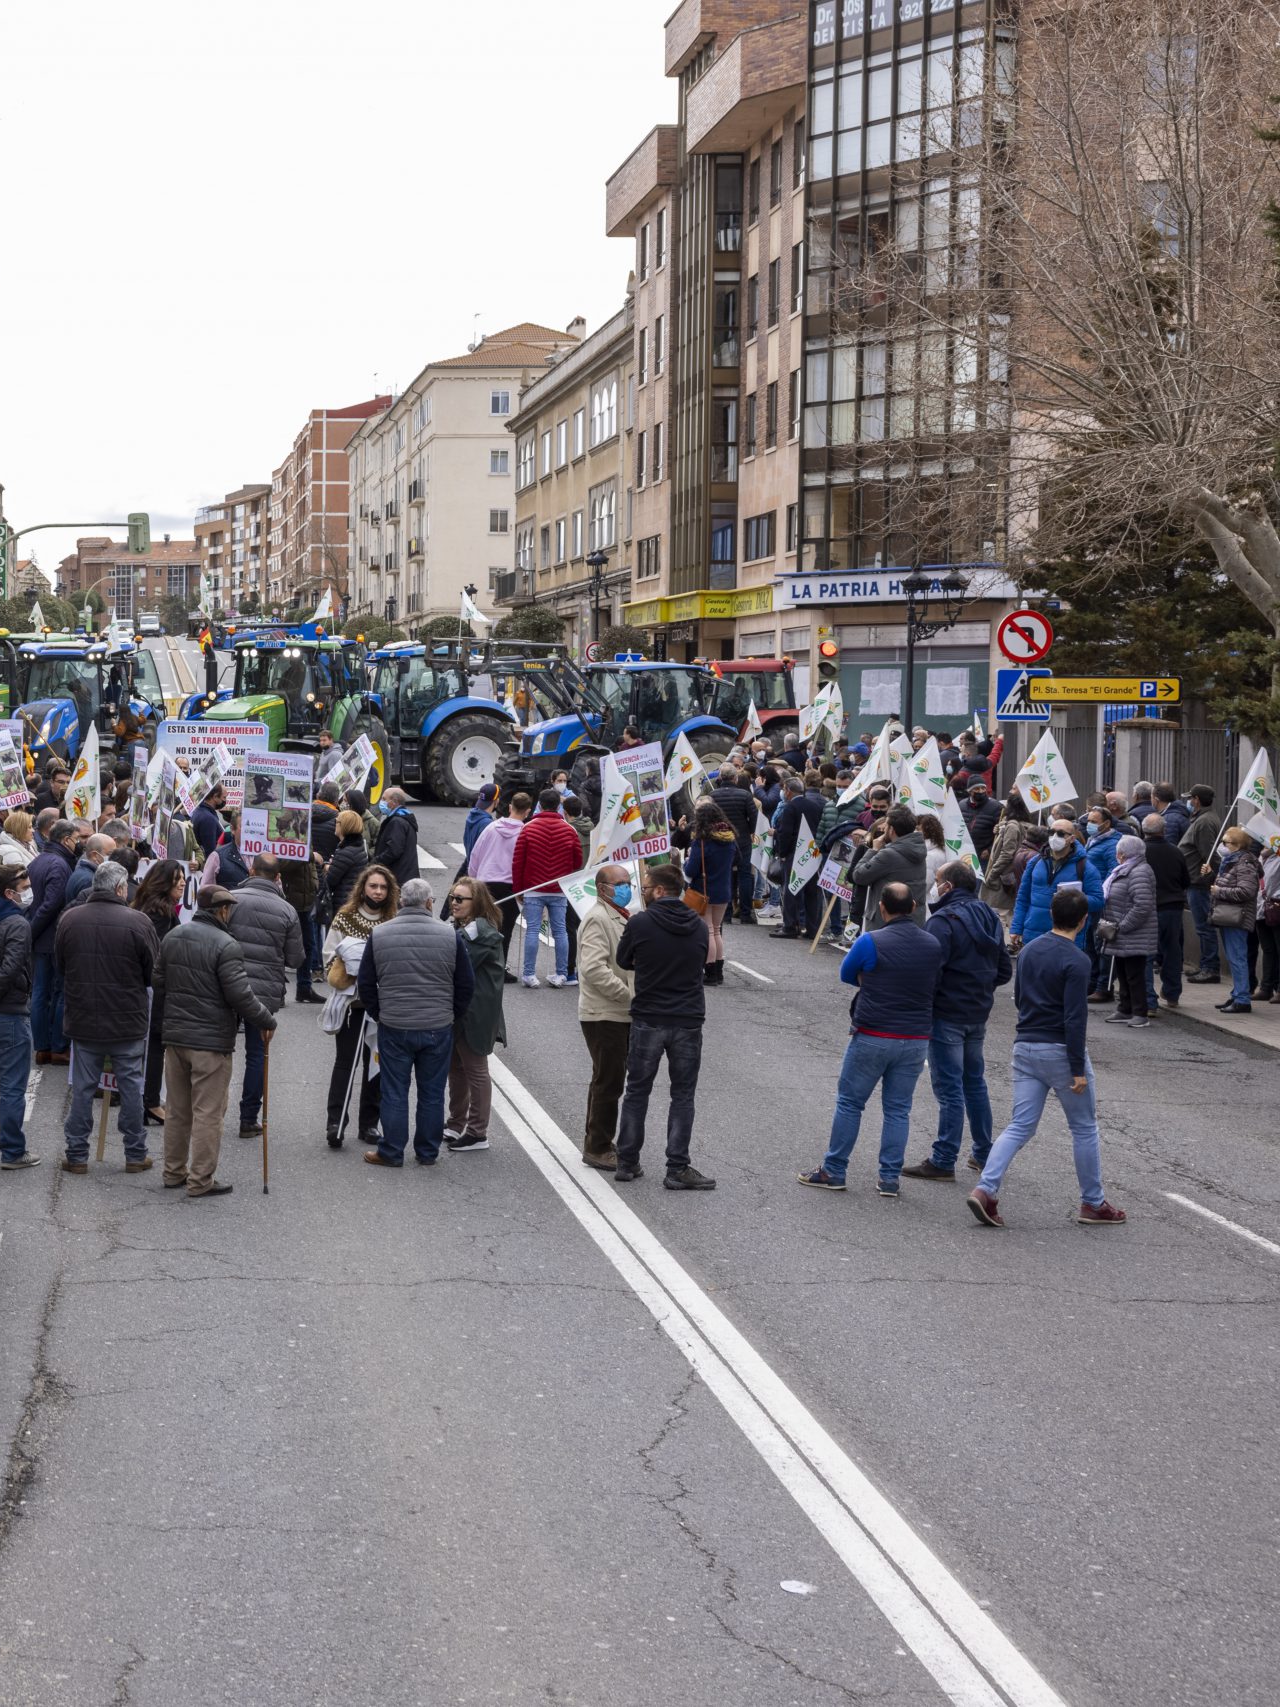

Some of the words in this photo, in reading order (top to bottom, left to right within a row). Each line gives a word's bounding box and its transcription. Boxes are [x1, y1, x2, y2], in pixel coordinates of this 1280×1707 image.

[818, 8, 833, 25] Dr.
[791, 584, 812, 599] LA
[819, 581, 880, 598] PATRIA
[1143, 682, 1154, 697] P
[167, 726, 186, 734] ESTA
[187, 726, 196, 734] ES
[198, 726, 208, 734] MI
[209, 726, 264, 735] HERRAMIENTA
[191, 736, 200, 744] DE
[176, 747, 186, 755] NO
[188, 747, 197, 755] ES
[199, 747, 209, 755] UN
[192, 757, 200, 765] MI
[248, 757, 288, 766] SUPERVIVENCIA
[247, 765, 279, 774] GANADERÍA
[5, 793, 27, 807] LOBO
[1246, 790, 1264, 807] UPA
[245, 840, 262, 853] NO
[263, 844, 270, 852] AL
[272, 843, 306, 858] LOBO
[612, 846, 628, 862] NO
[637, 837, 668, 856] LOBO
[791, 877, 804, 892] UPA
[820, 879, 831, 890] NO
